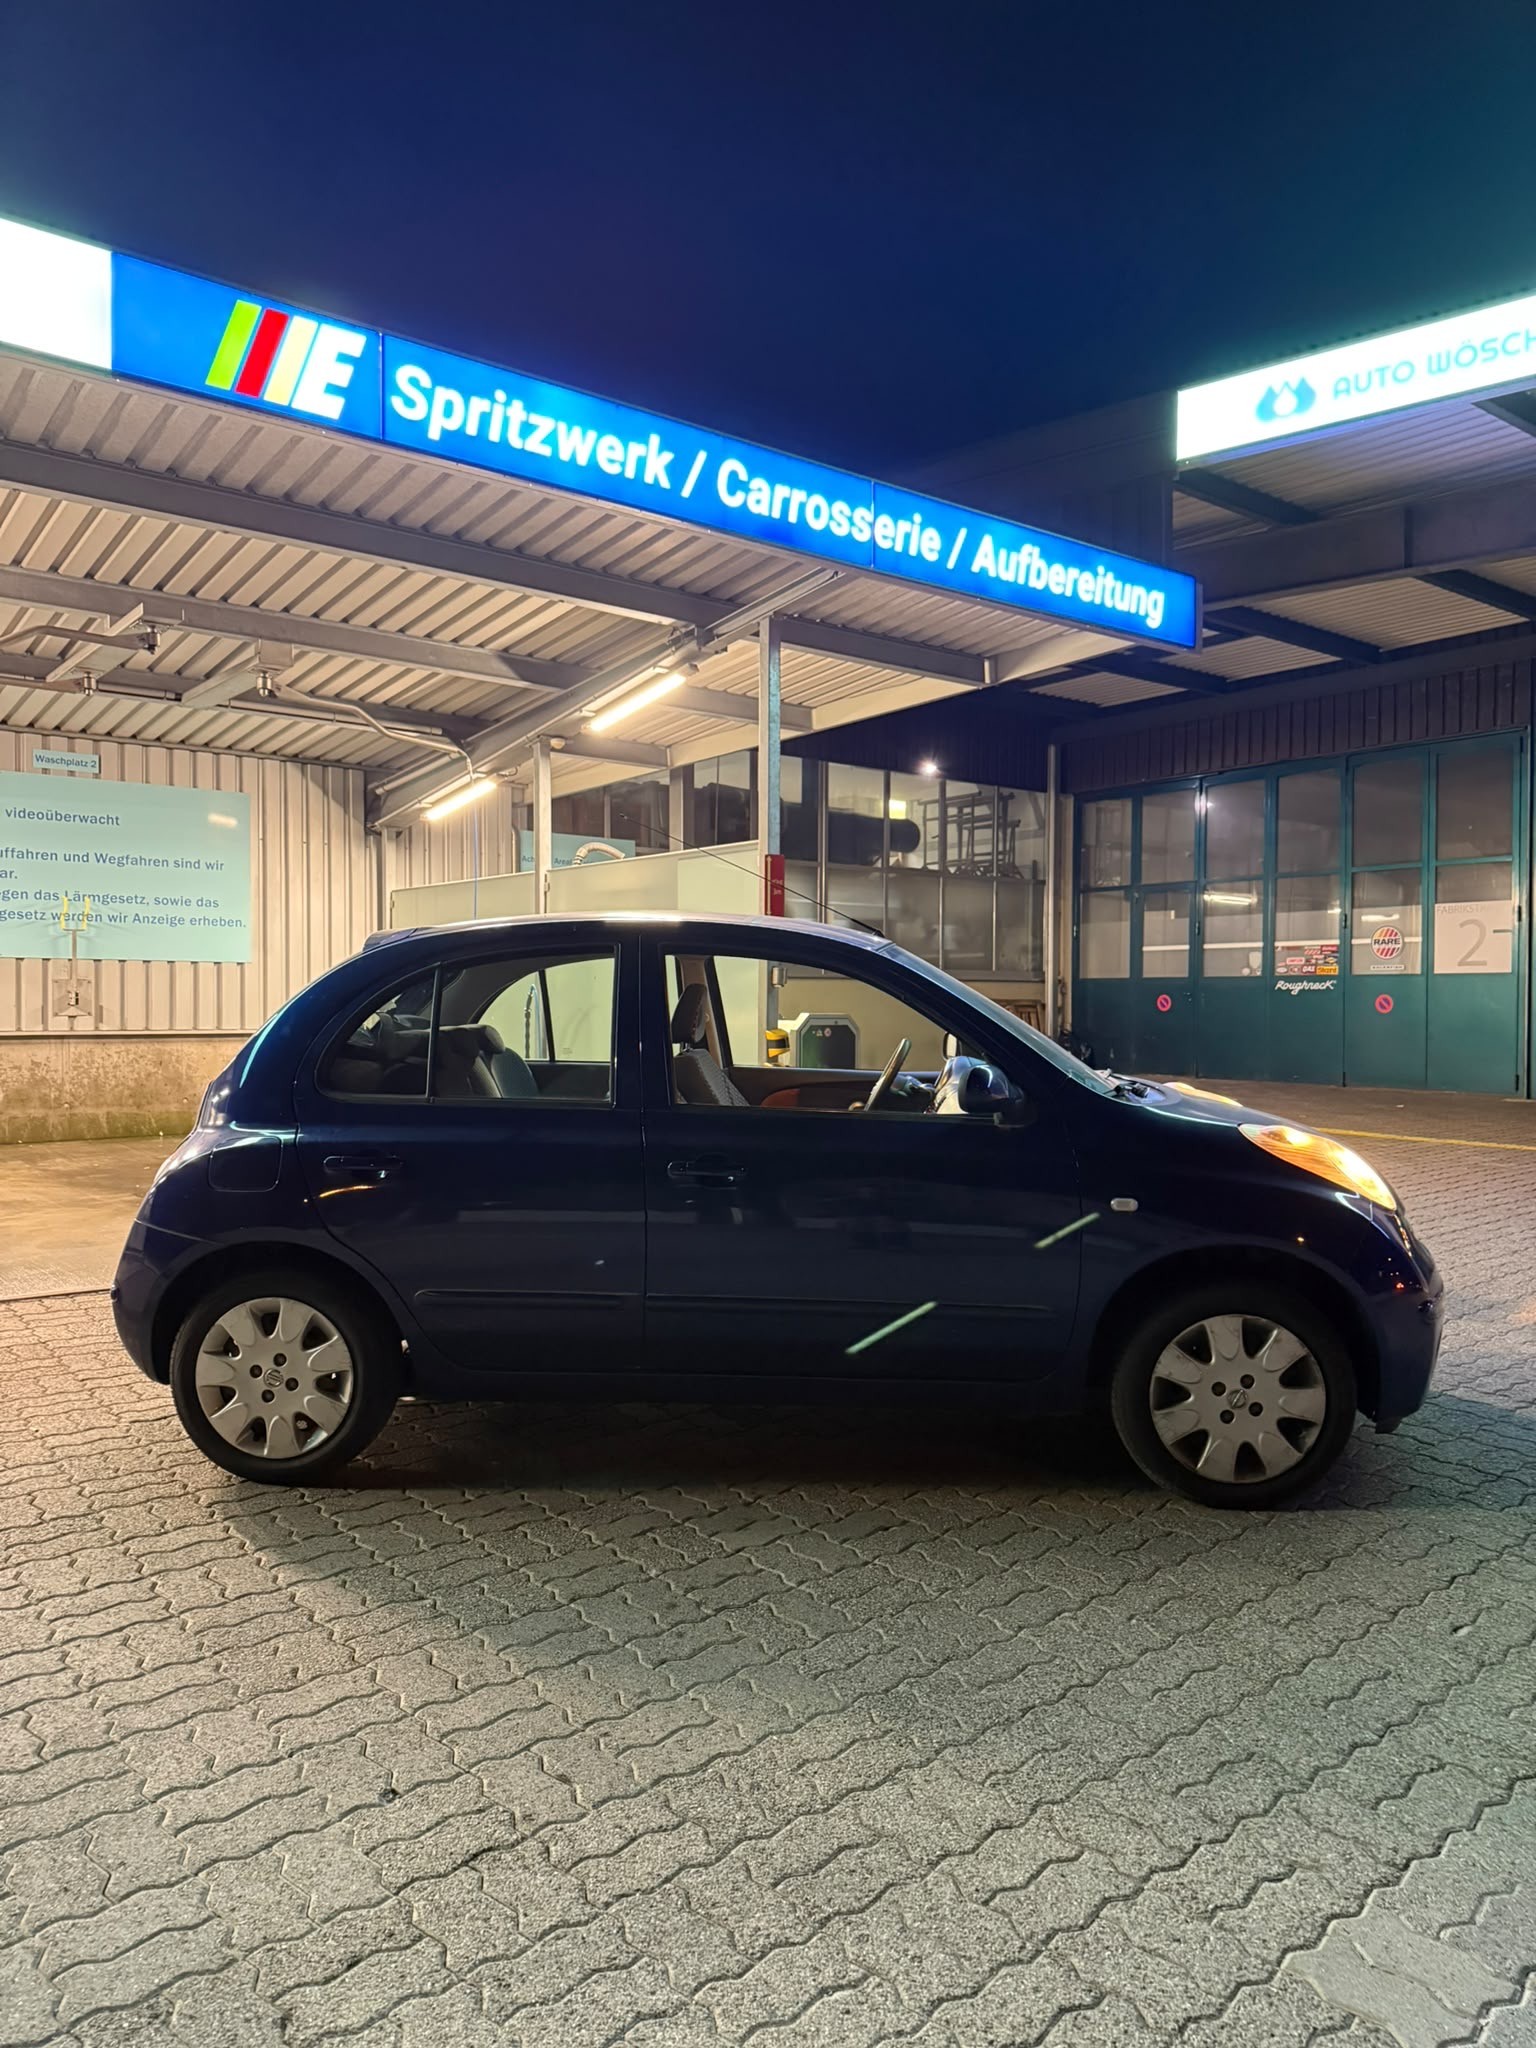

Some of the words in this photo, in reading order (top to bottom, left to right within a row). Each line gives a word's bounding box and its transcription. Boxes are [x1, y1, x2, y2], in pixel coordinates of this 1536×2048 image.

[1332, 361, 1415, 400] AUTO
[391, 365, 673, 488] Spritzwerk
[718, 459, 941, 561] Carrosserie
[972, 535, 1164, 628] Aufbereitung
[35, 754, 88, 768] Waschplatz
[90, 760, 97, 768] 2
[5, 807, 120, 826] videoüberwacht
[63, 852, 90, 863] und
[94, 852, 169, 868] Wegfahren
[173, 857, 201, 870] sind
[205, 860, 225, 871] wir
[0, 889, 29, 901] gen
[33, 889, 60, 901] das
[64, 890, 150, 906] Lärmgesetz,
[153, 896, 192, 906] sowie
[196, 897, 220, 908] das
[51, 911, 103, 923] werden
[107, 912, 128, 923] wir
[132, 913, 185, 928] Anzeige
[189, 915, 246, 928] erheben.
[1373, 937, 1401, 945] RARE
[1457, 918, 1488, 968] 2
